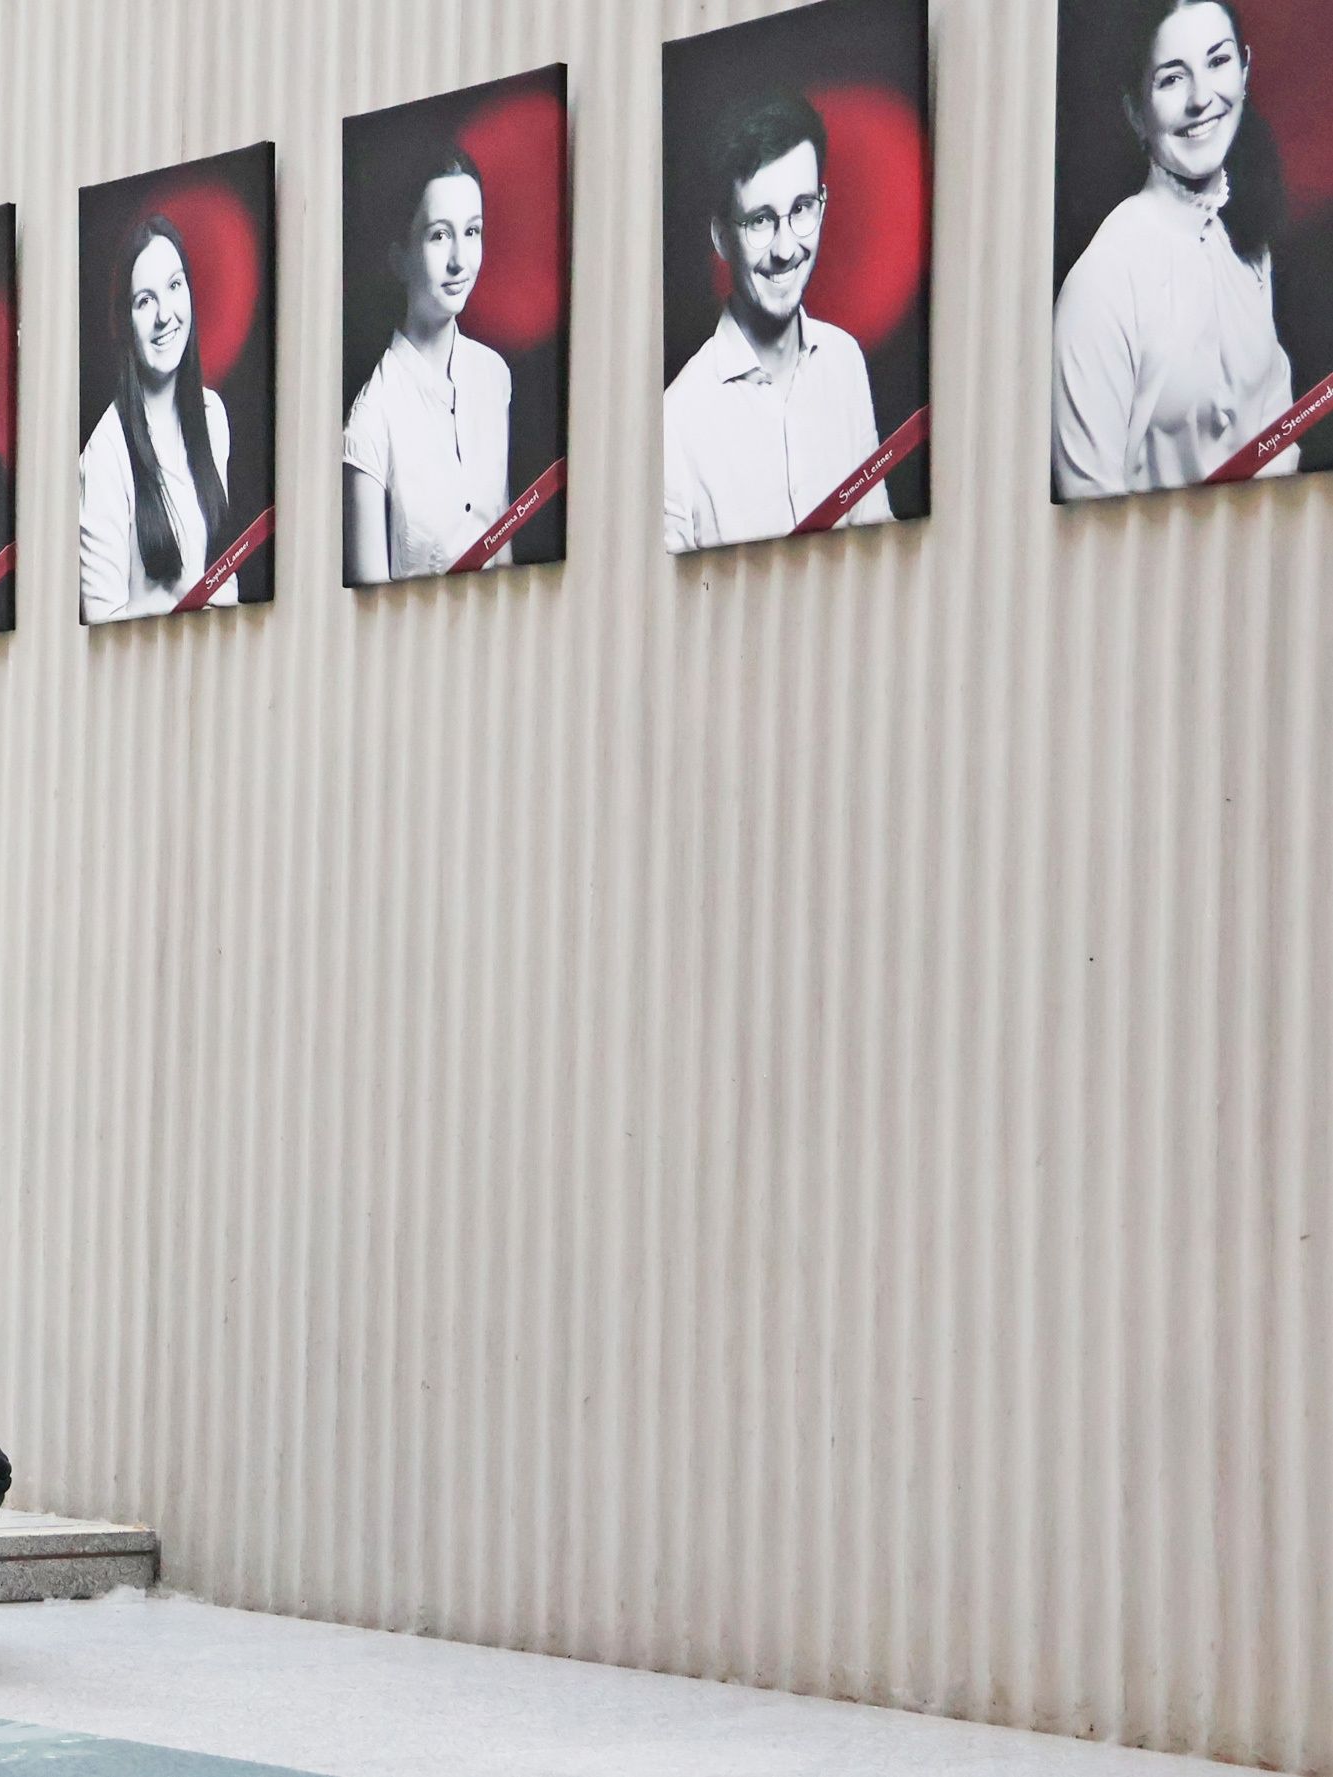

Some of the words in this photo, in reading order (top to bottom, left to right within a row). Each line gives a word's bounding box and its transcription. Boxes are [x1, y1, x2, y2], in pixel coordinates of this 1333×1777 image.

[1257, 433, 1281, 458] Anja
[838, 477, 865, 505] Simon
[863, 449, 894, 481] Leitner
[483, 515, 518, 550] Florentina
[516, 489, 540, 518] Baierl
[205, 564, 227, 590] Sophie
